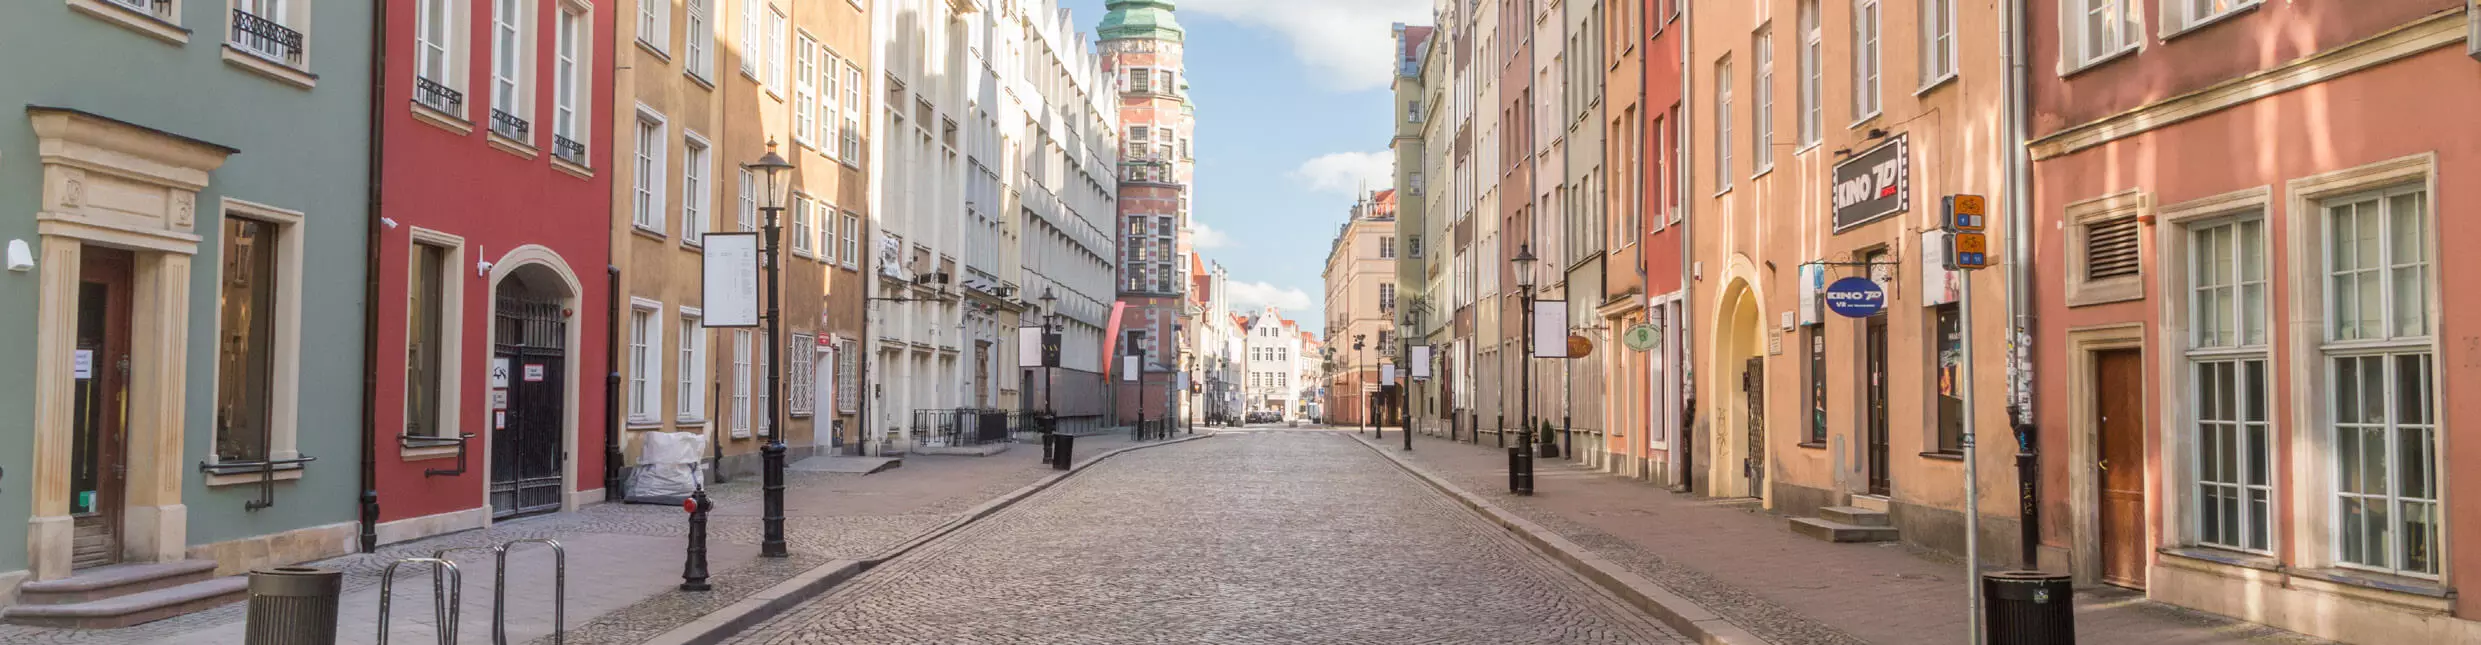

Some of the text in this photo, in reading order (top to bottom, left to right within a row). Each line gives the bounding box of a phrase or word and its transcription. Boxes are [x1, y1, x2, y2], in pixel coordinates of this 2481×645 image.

[1838, 158, 1898, 209] KINO 7D
[1827, 290, 1882, 301] KINO 7D
